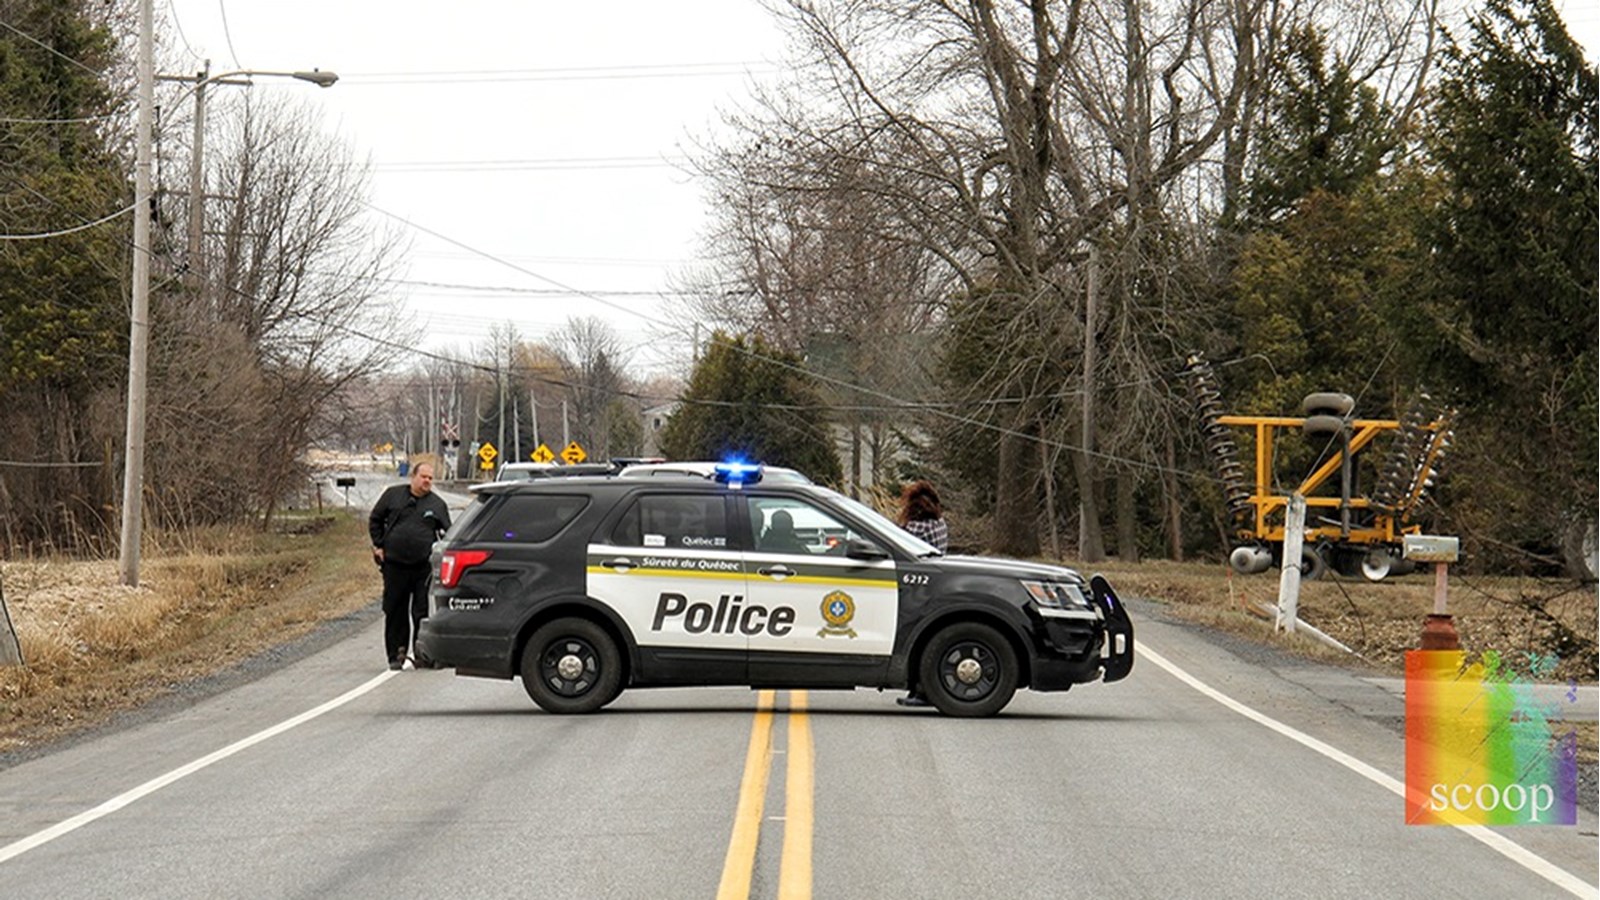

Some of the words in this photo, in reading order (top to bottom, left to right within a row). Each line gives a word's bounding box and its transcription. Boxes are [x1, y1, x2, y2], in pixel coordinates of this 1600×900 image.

[682, 535, 714, 548] Québec
[641, 556, 678, 568] Sûreté
[681, 560, 696, 569] du
[698, 560, 740, 571] Québec
[903, 574, 930, 585] 6212
[651, 592, 796, 637] Police
